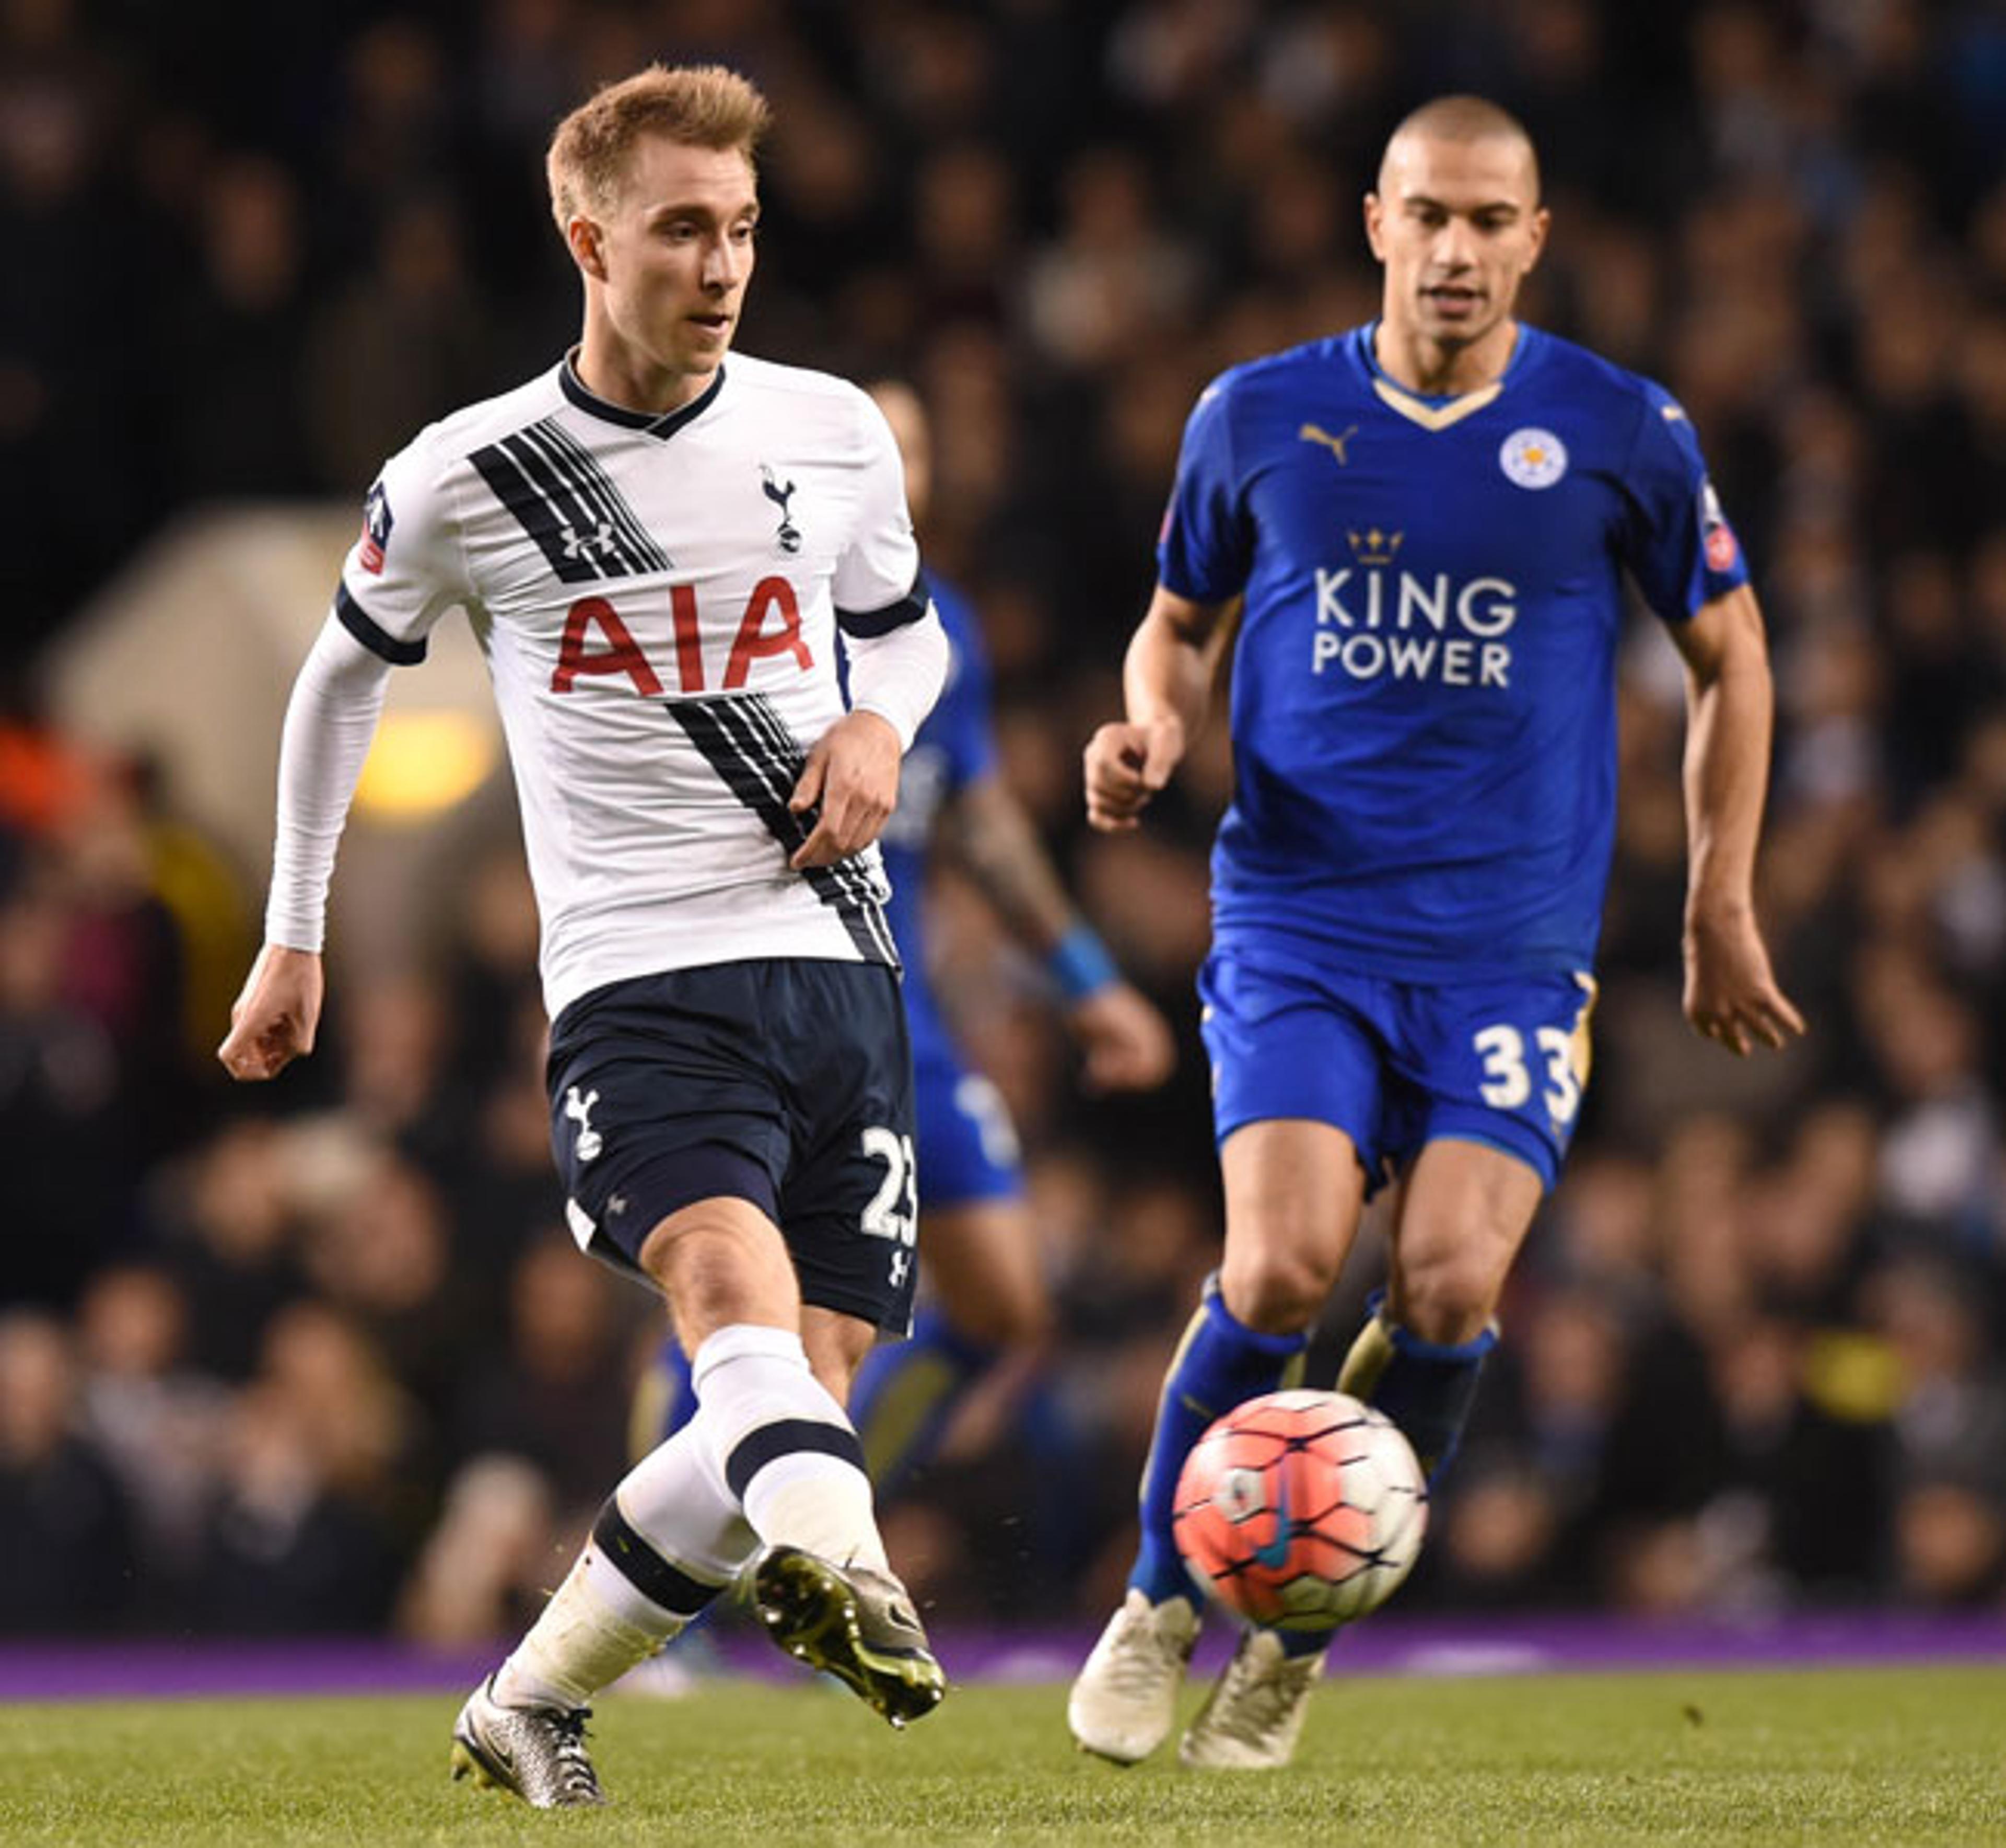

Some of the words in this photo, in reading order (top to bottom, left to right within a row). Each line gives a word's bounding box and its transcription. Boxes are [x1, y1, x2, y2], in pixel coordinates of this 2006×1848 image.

[551, 576, 815, 696] AIA
[1314, 568, 1517, 636] KING
[1311, 631, 1512, 688] POWER
[1474, 1024, 1581, 1124] 33
